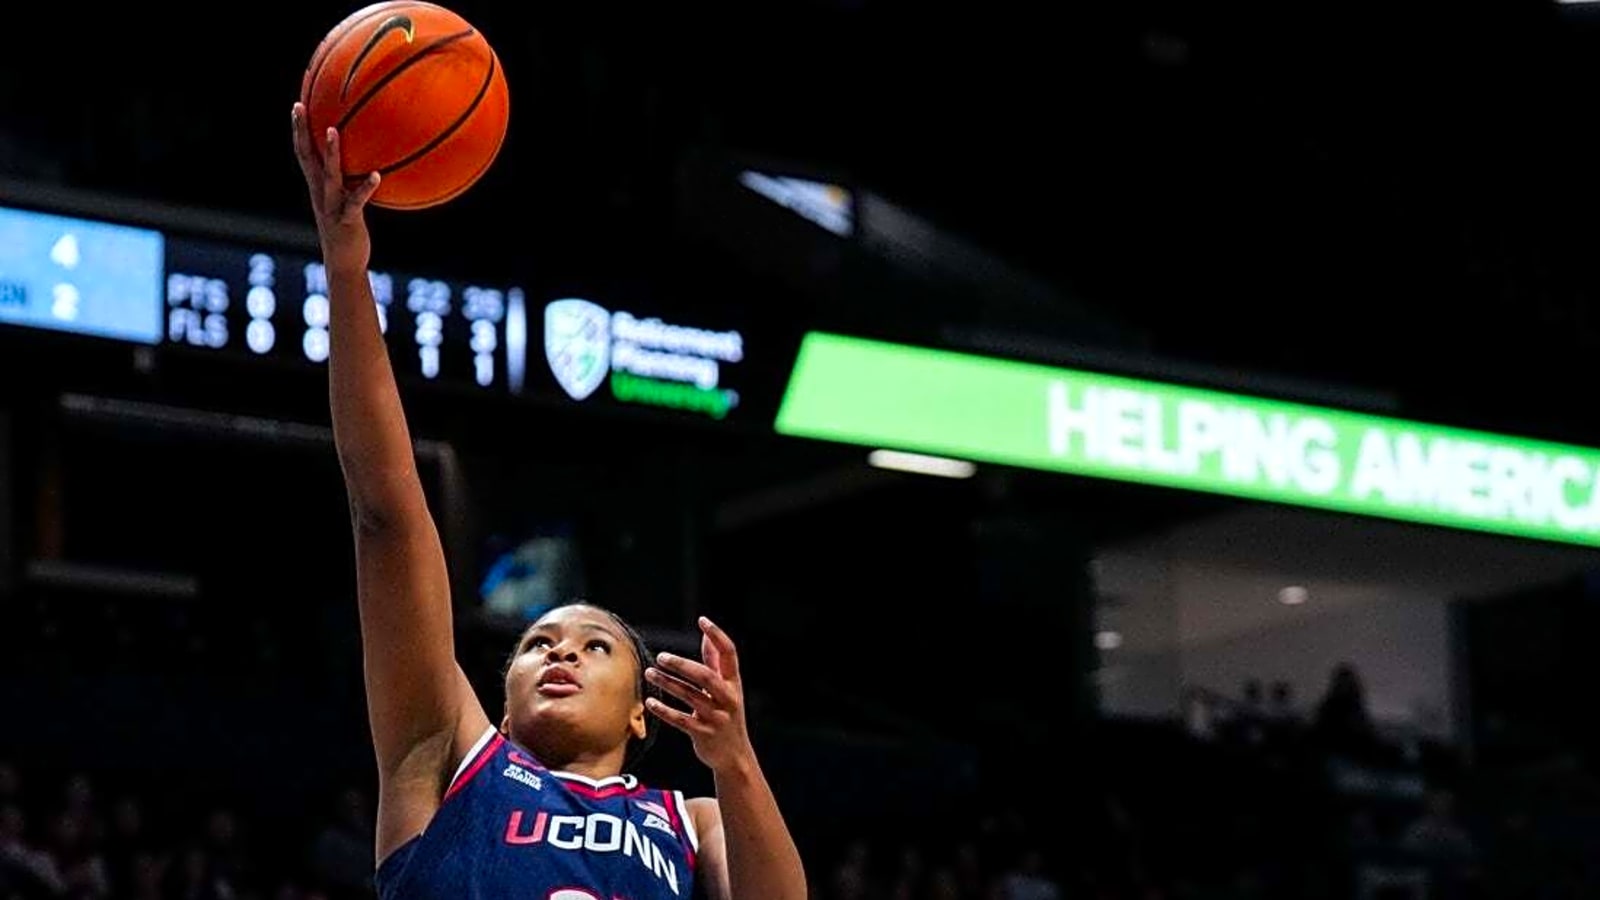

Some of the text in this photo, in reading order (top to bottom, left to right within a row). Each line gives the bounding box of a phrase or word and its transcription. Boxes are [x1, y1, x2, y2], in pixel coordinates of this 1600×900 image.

[51, 233, 80, 269] 4
[248, 253, 275, 286] 2
[407, 277, 453, 317] 22
[50, 282, 80, 320] 2
[247, 285, 276, 321] 0
[415, 311, 443, 346] 2
[469, 318, 498, 355] 3
[168, 306, 229, 349] FLS
[247, 318, 276, 355] 0
[418, 343, 440, 379] 1
[474, 352, 495, 386] 1
[1047, 380, 1339, 496] HELPING
[505, 810, 680, 896] UCONN
